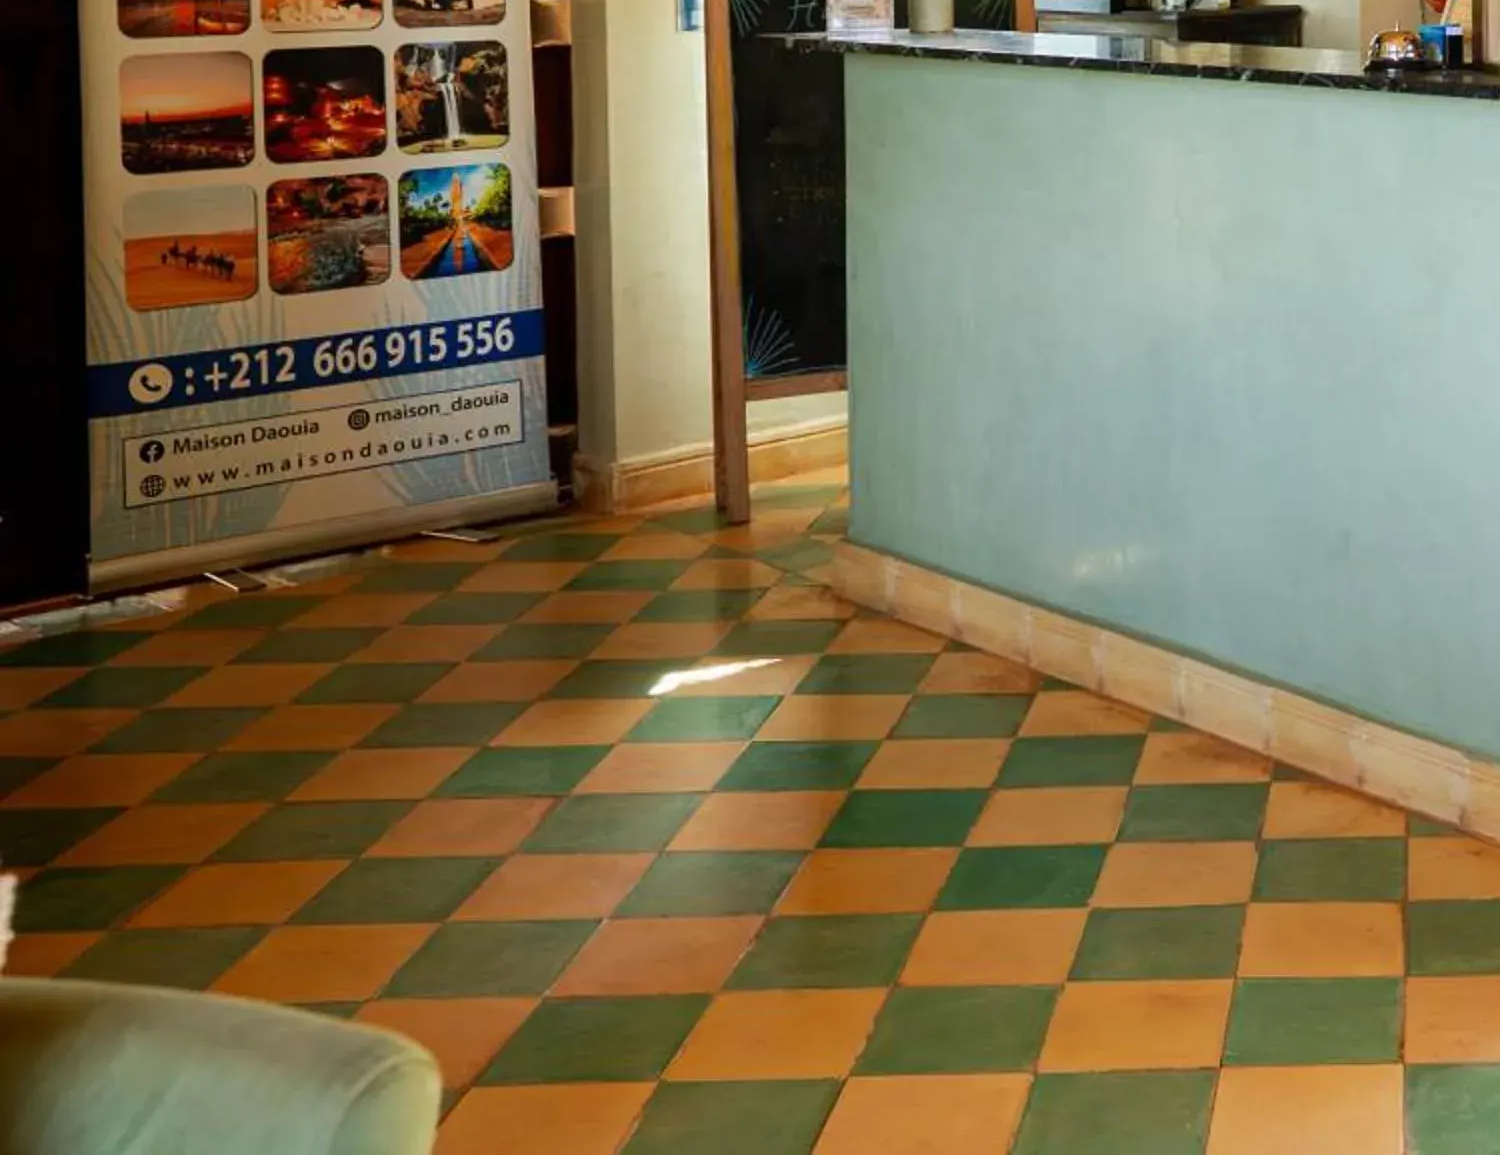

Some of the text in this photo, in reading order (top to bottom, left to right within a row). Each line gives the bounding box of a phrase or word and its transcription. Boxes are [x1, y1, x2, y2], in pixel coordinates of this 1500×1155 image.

[313, 334, 378, 377] 666
[386, 326, 448, 368] 915
[456, 316, 515, 358] 556
[375, 390, 510, 424] maison_daouia
[173, 419, 320, 456] Maison Daouia
[173, 421, 511, 490] www.maisondaouia.com
